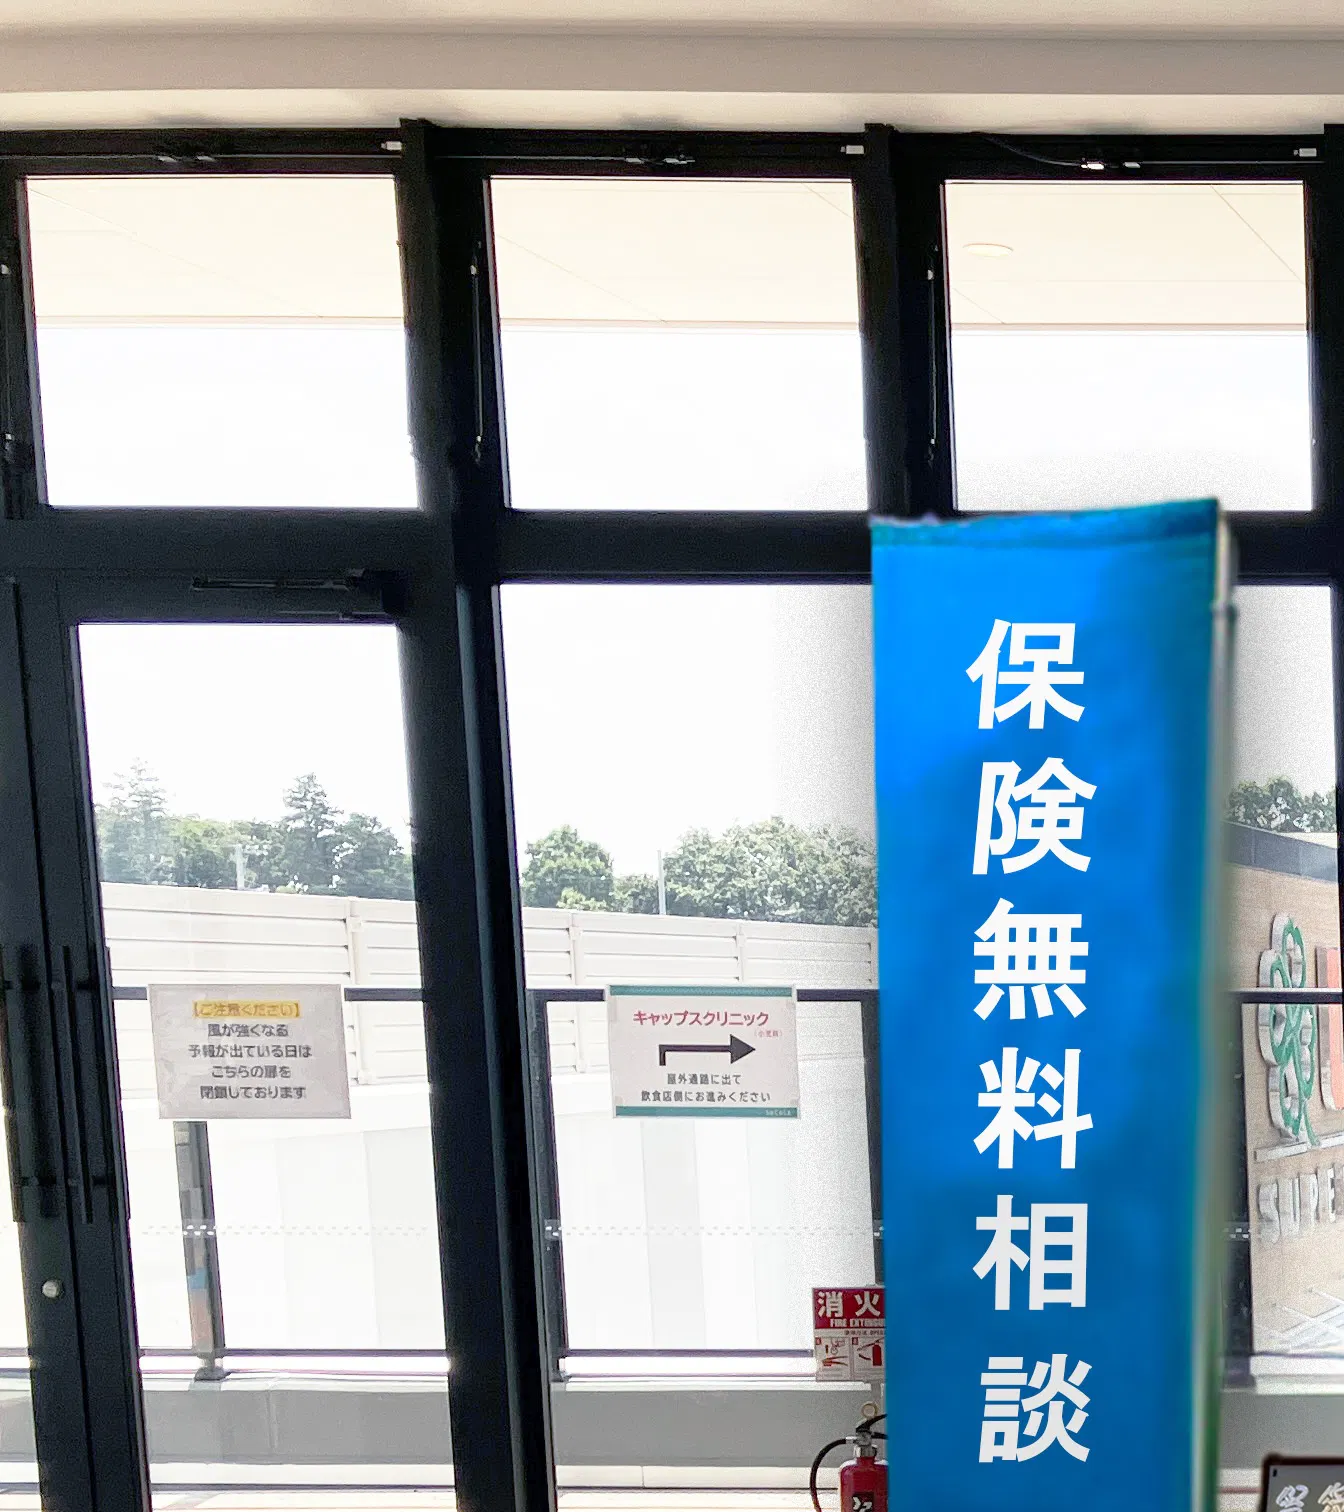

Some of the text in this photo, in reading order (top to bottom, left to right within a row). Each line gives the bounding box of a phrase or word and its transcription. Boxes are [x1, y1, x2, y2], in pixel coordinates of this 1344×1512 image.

[632, 1010, 770, 1027] キャップスクリニック
[207, 1024, 289, 1037] 風が強くなる
[965, 618, 1099, 1464] 保険無料相談
[188, 1044, 313, 1059] 予報が出ている日は
[211, 1065, 292, 1079] こちらの扉を
[667, 1073, 742, 1086] 屋外通路に出て
[200, 1085, 306, 1099] 閉鎖しております
[641, 1090, 771, 1103] 飲食店側にお進みください
